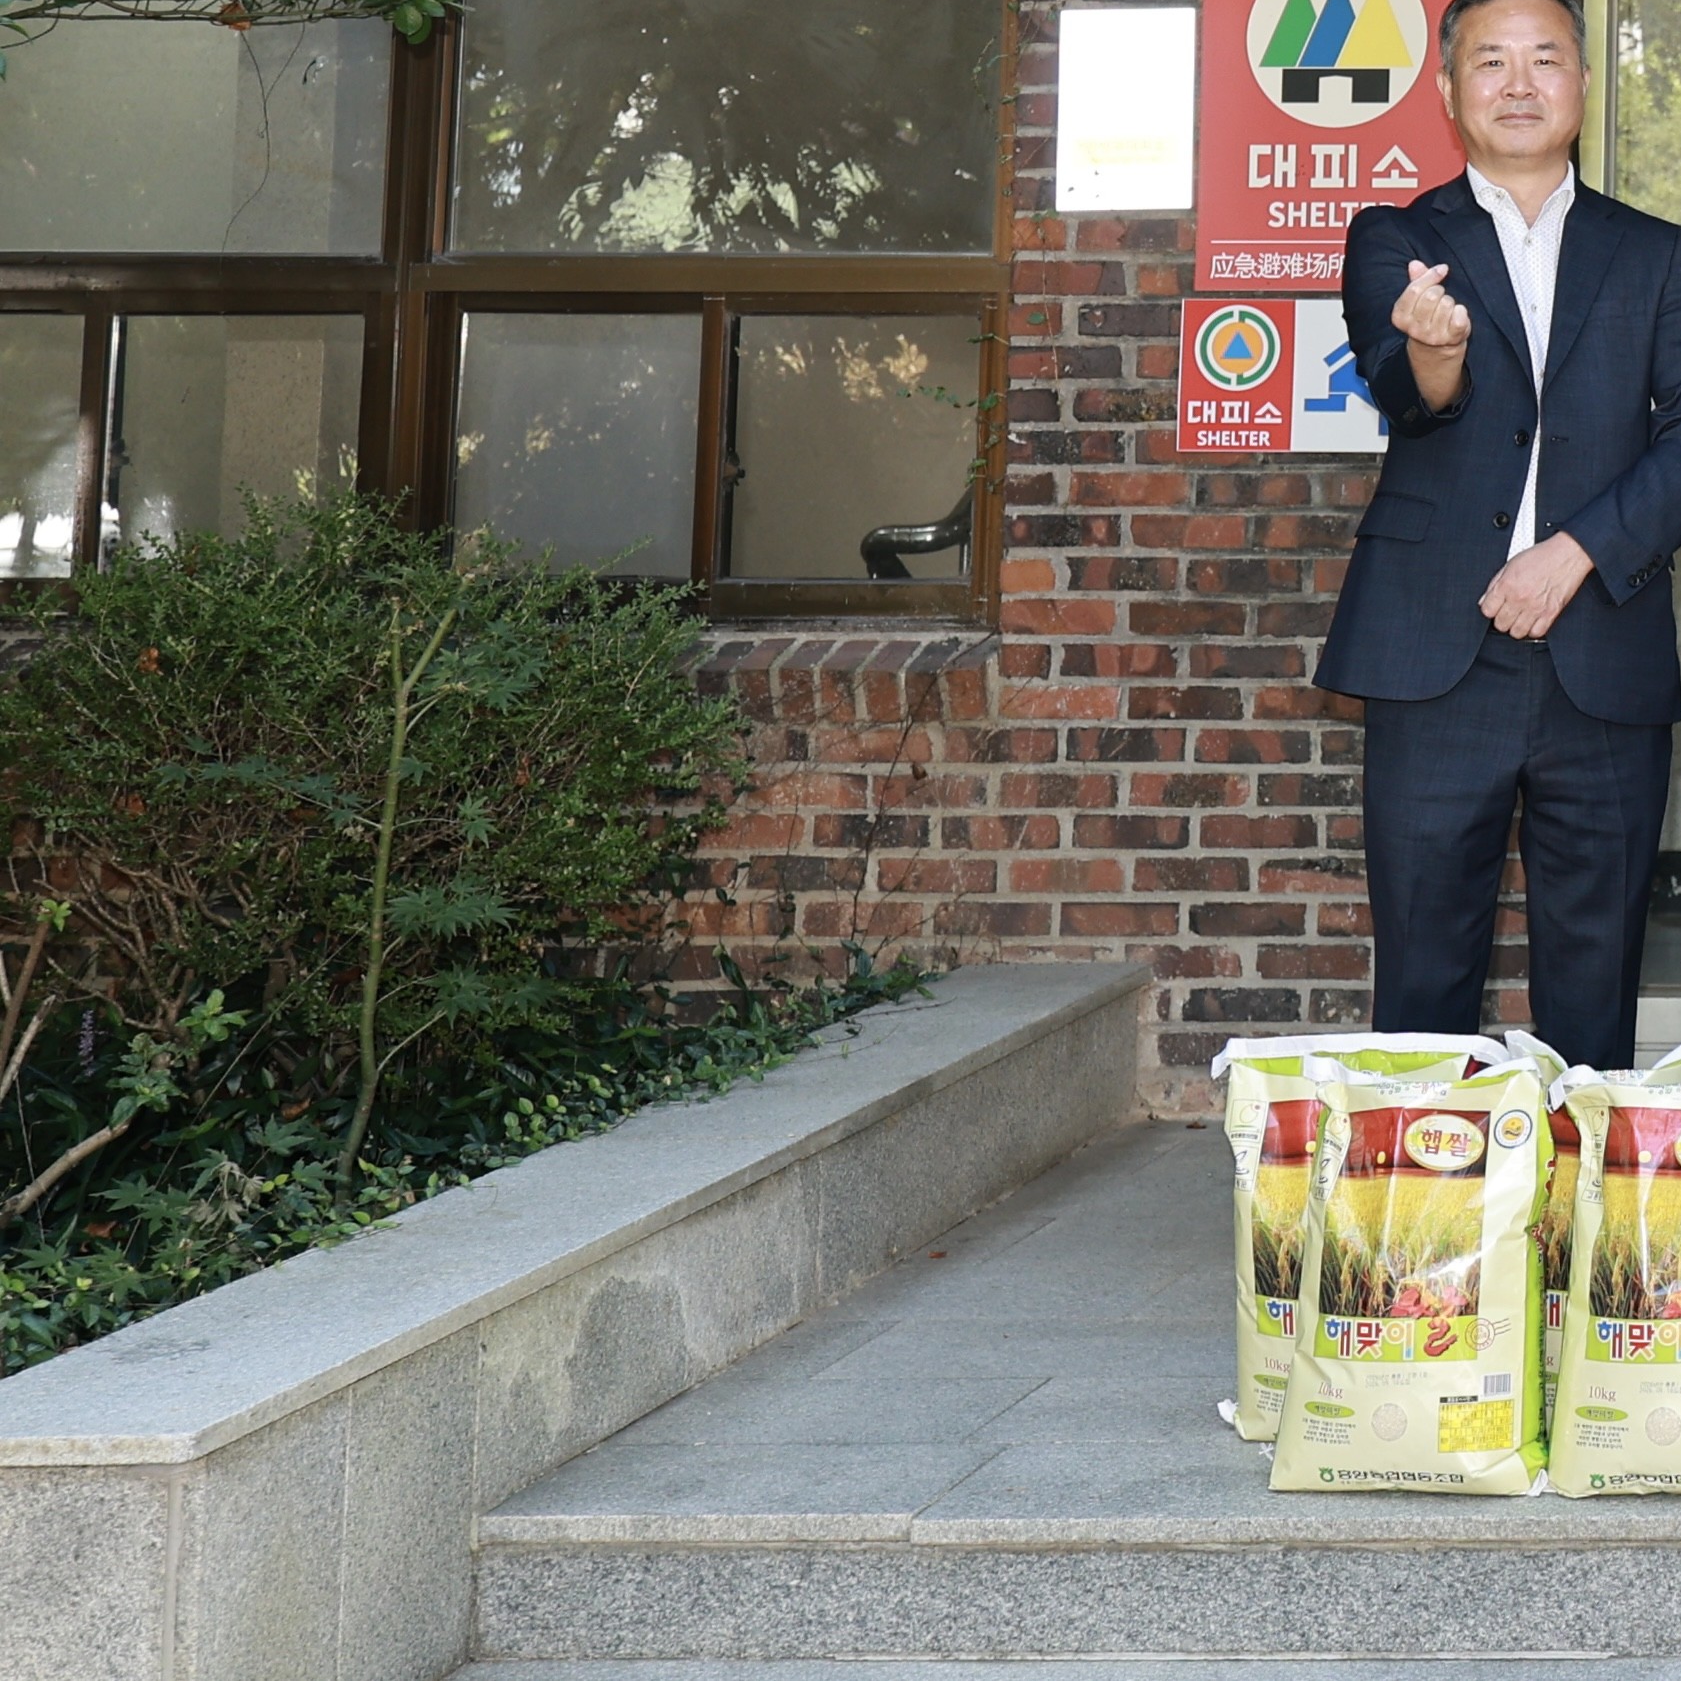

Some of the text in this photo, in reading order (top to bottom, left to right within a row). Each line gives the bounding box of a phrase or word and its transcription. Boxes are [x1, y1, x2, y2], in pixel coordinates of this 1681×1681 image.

[1248, 144, 1419, 188] 대피소
[1268, 201, 1397, 228] SHELT
[1187, 400, 1283, 424] 대피소
[1197, 430, 1271, 447] SHELTER
[1420, 1128, 1471, 1157] 햅쌀
[1325, 1318, 1415, 1360] 해맞이
[1318, 1382, 1344, 1400] 10kg
[1588, 1385, 1616, 1402] 10kg
